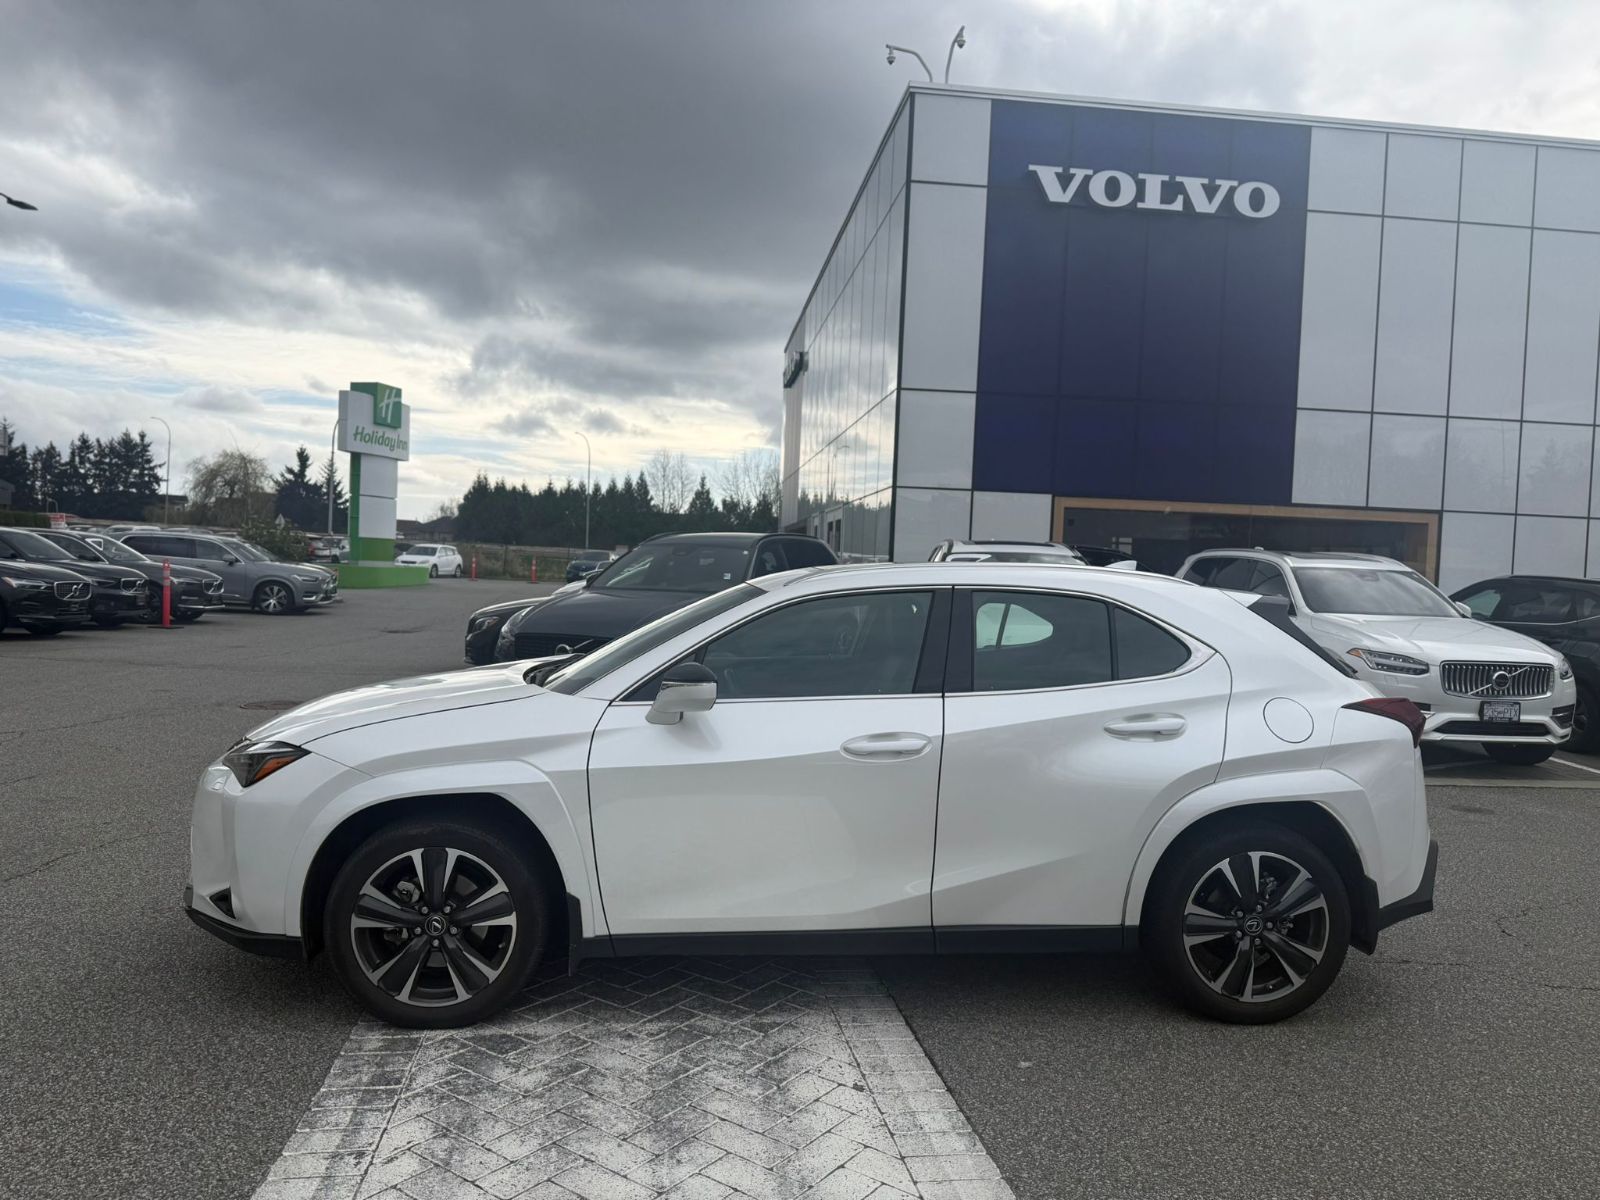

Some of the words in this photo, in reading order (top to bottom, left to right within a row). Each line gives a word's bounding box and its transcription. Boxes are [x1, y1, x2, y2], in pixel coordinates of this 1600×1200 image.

[1028, 164, 1280, 218] VOLVO
[353, 425, 395, 451] Holiday
[396, 434, 408, 450] Inn
